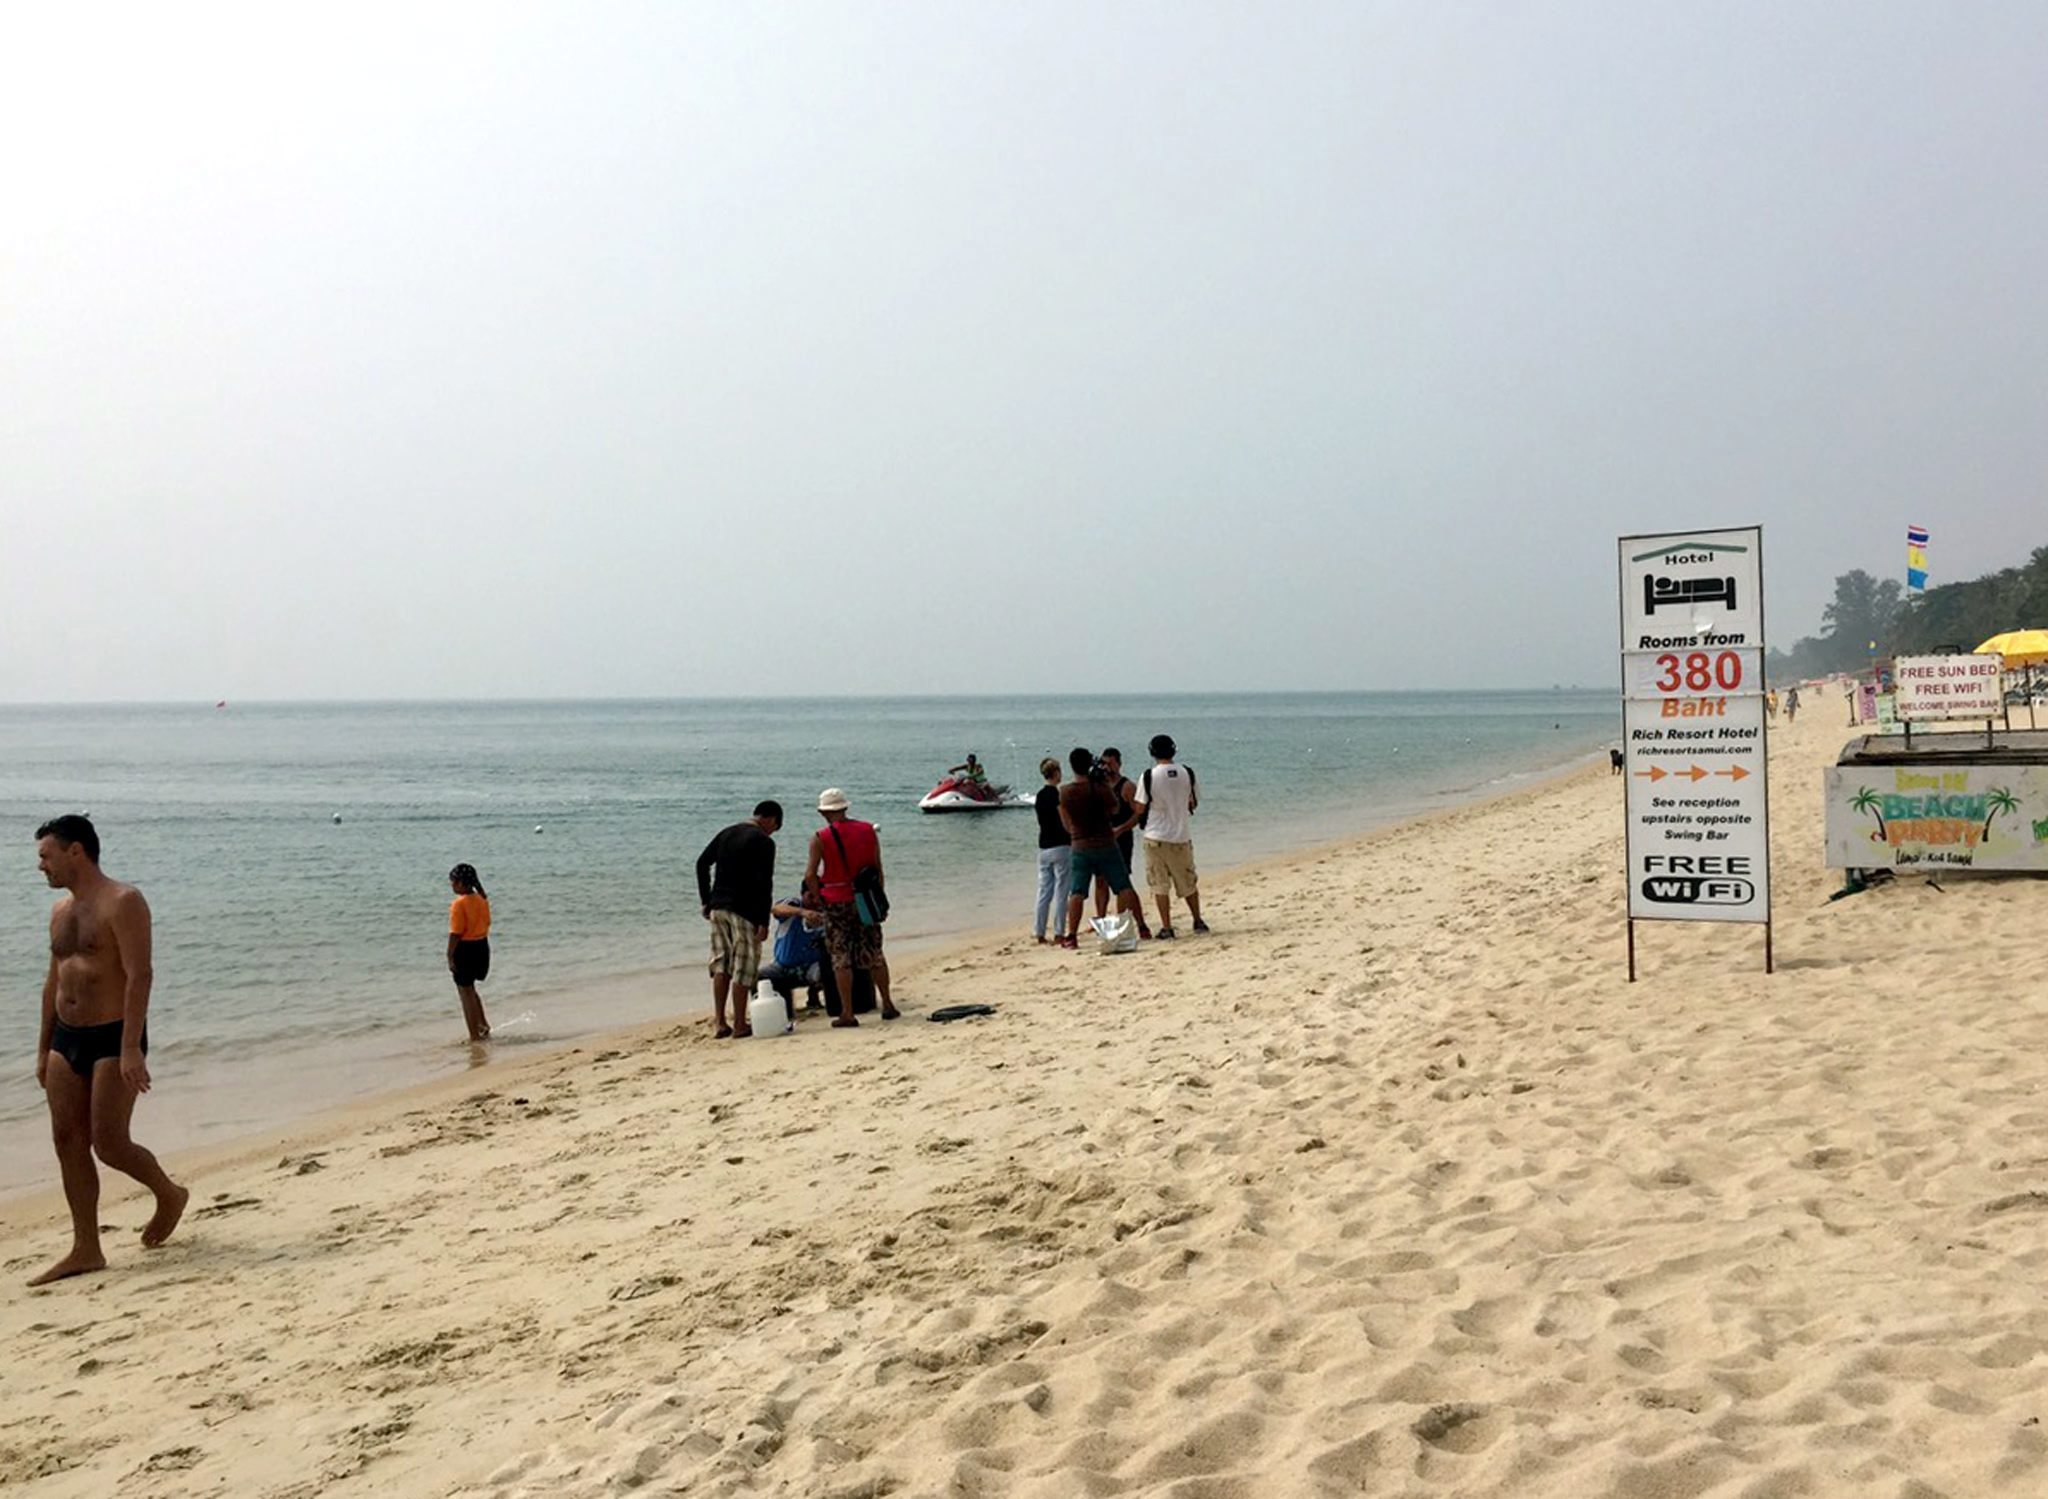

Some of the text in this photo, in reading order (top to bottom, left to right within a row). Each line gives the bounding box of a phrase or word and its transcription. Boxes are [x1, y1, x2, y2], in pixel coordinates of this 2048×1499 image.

[1665, 551, 1714, 565] Hotel
[1639, 632, 1745, 649] Rooms from
[1655, 650, 1742, 693] 380
[1900, 664, 1998, 679] FREE SUN BED
[1915, 682, 1983, 695] FREE WIFI
[1661, 695, 1727, 718] Baht
[1898, 701, 1945, 711] WELCOME
[1980, 700, 1998, 709] BAR
[1632, 727, 1758, 741] Rich Resort Hotel
[1637, 745, 1753, 756] richresortsamui.com
[1652, 797, 1740, 810] See reception
[1883, 793, 1986, 821] BEACH
[1641, 814, 1752, 826] upstairs opposite
[1664, 830, 1730, 842] Swing Bar
[1644, 855, 1751, 875] FREE
